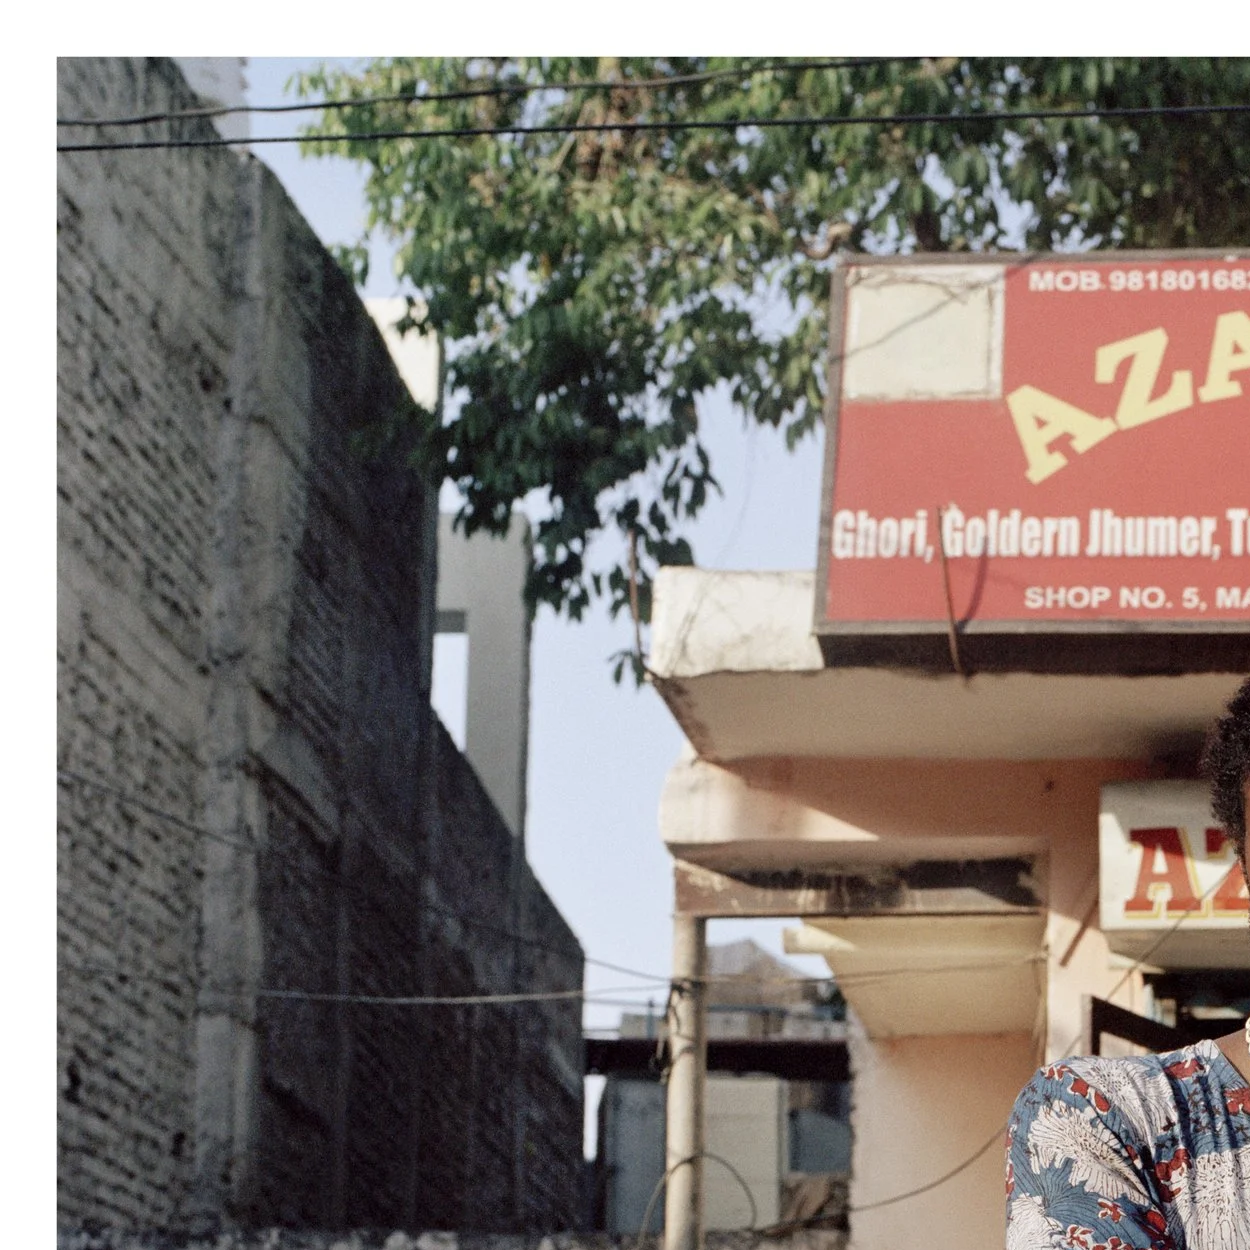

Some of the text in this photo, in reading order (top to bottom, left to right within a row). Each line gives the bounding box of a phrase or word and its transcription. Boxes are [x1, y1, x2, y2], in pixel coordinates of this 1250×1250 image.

[832, 509, 934, 563] Ghori,
[943, 507, 1080, 558] Goldern
[1085, 508, 1221, 561] Jhumer,
[1025, 586, 1111, 610] SHOP
[1119, 586, 1173, 609] NO.
[1182, 586, 1208, 612] 5,
